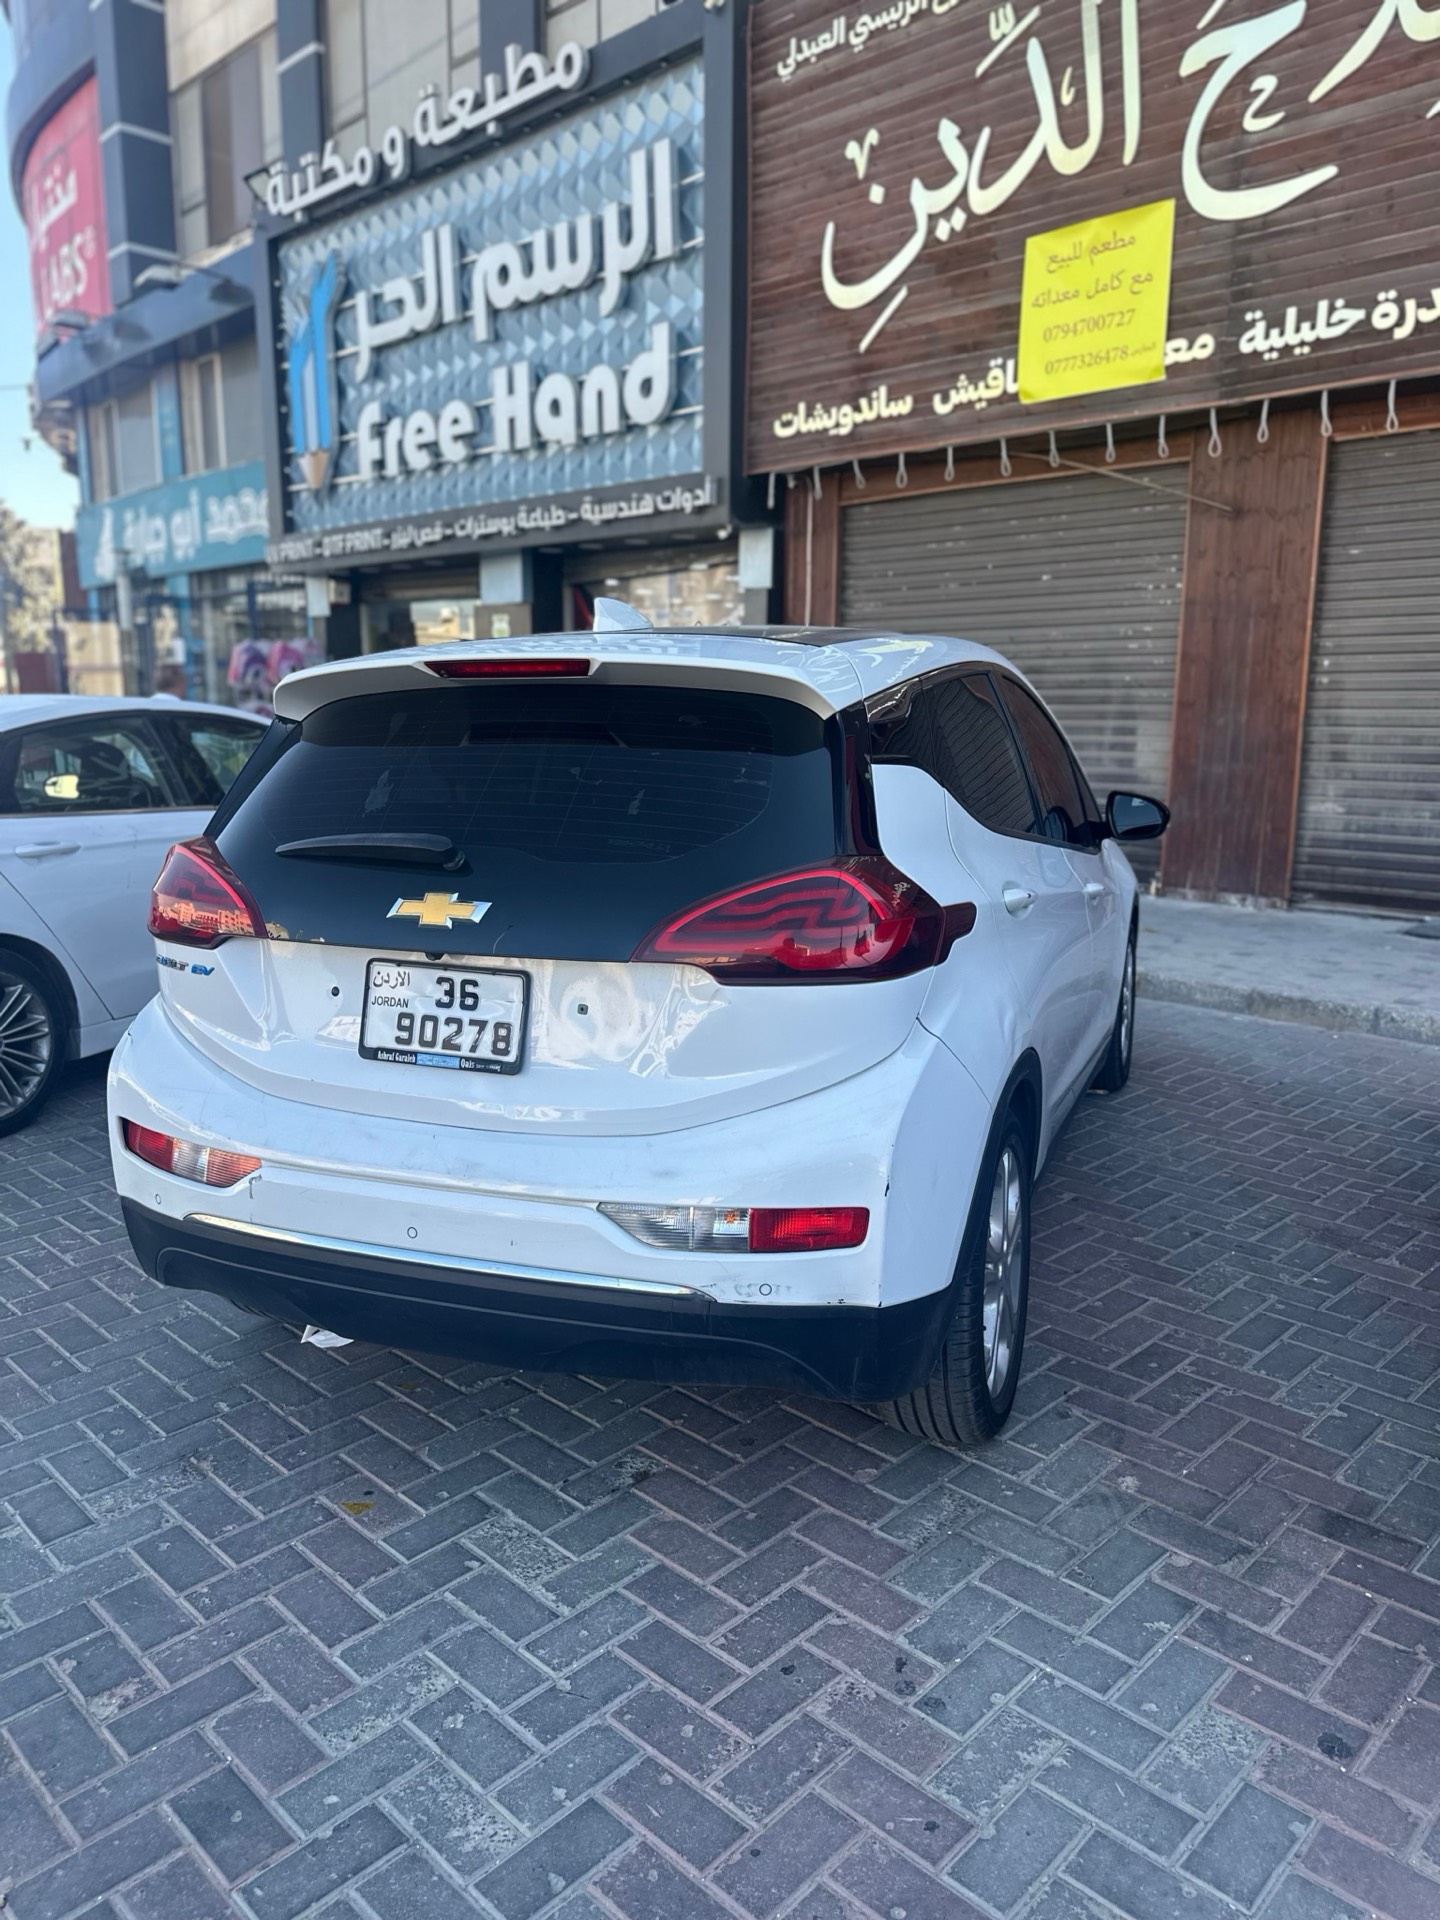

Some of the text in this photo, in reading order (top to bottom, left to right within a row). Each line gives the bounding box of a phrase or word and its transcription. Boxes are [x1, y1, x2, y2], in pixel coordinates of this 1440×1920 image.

[776, 15, 846, 83] العبدلي
[265, 40, 588, 221] مطبعة و مكتبة
[355, 137, 679, 384] الرسم الحر
[1046, 230, 1136, 274] مطعم للبيع
[1086, 269, 1125, 300] كامل
[1129, 272, 1153, 295] مع
[1043, 308, 1136, 343] 0794700727
[1238, 298, 1366, 361] خليلية
[1371, 289, 1440, 340] درة
[1045, 345, 1129, 375] 0777326478
[492, 321, 671, 453] Hand
[773, 357, 1020, 437] اقيش ساندويشات
[580, 492, 655, 526] هندسية
[656, 474, 712, 515] أدوات
[516, 505, 566, 531] طباعة
[279, 539, 314, 563] PRINT
[345, 527, 384, 552] PRINT
[371, 995, 409, 1009] JORDAN
[435, 976, 479, 1011] 36
[395, 1012, 512, 1057] 90278
